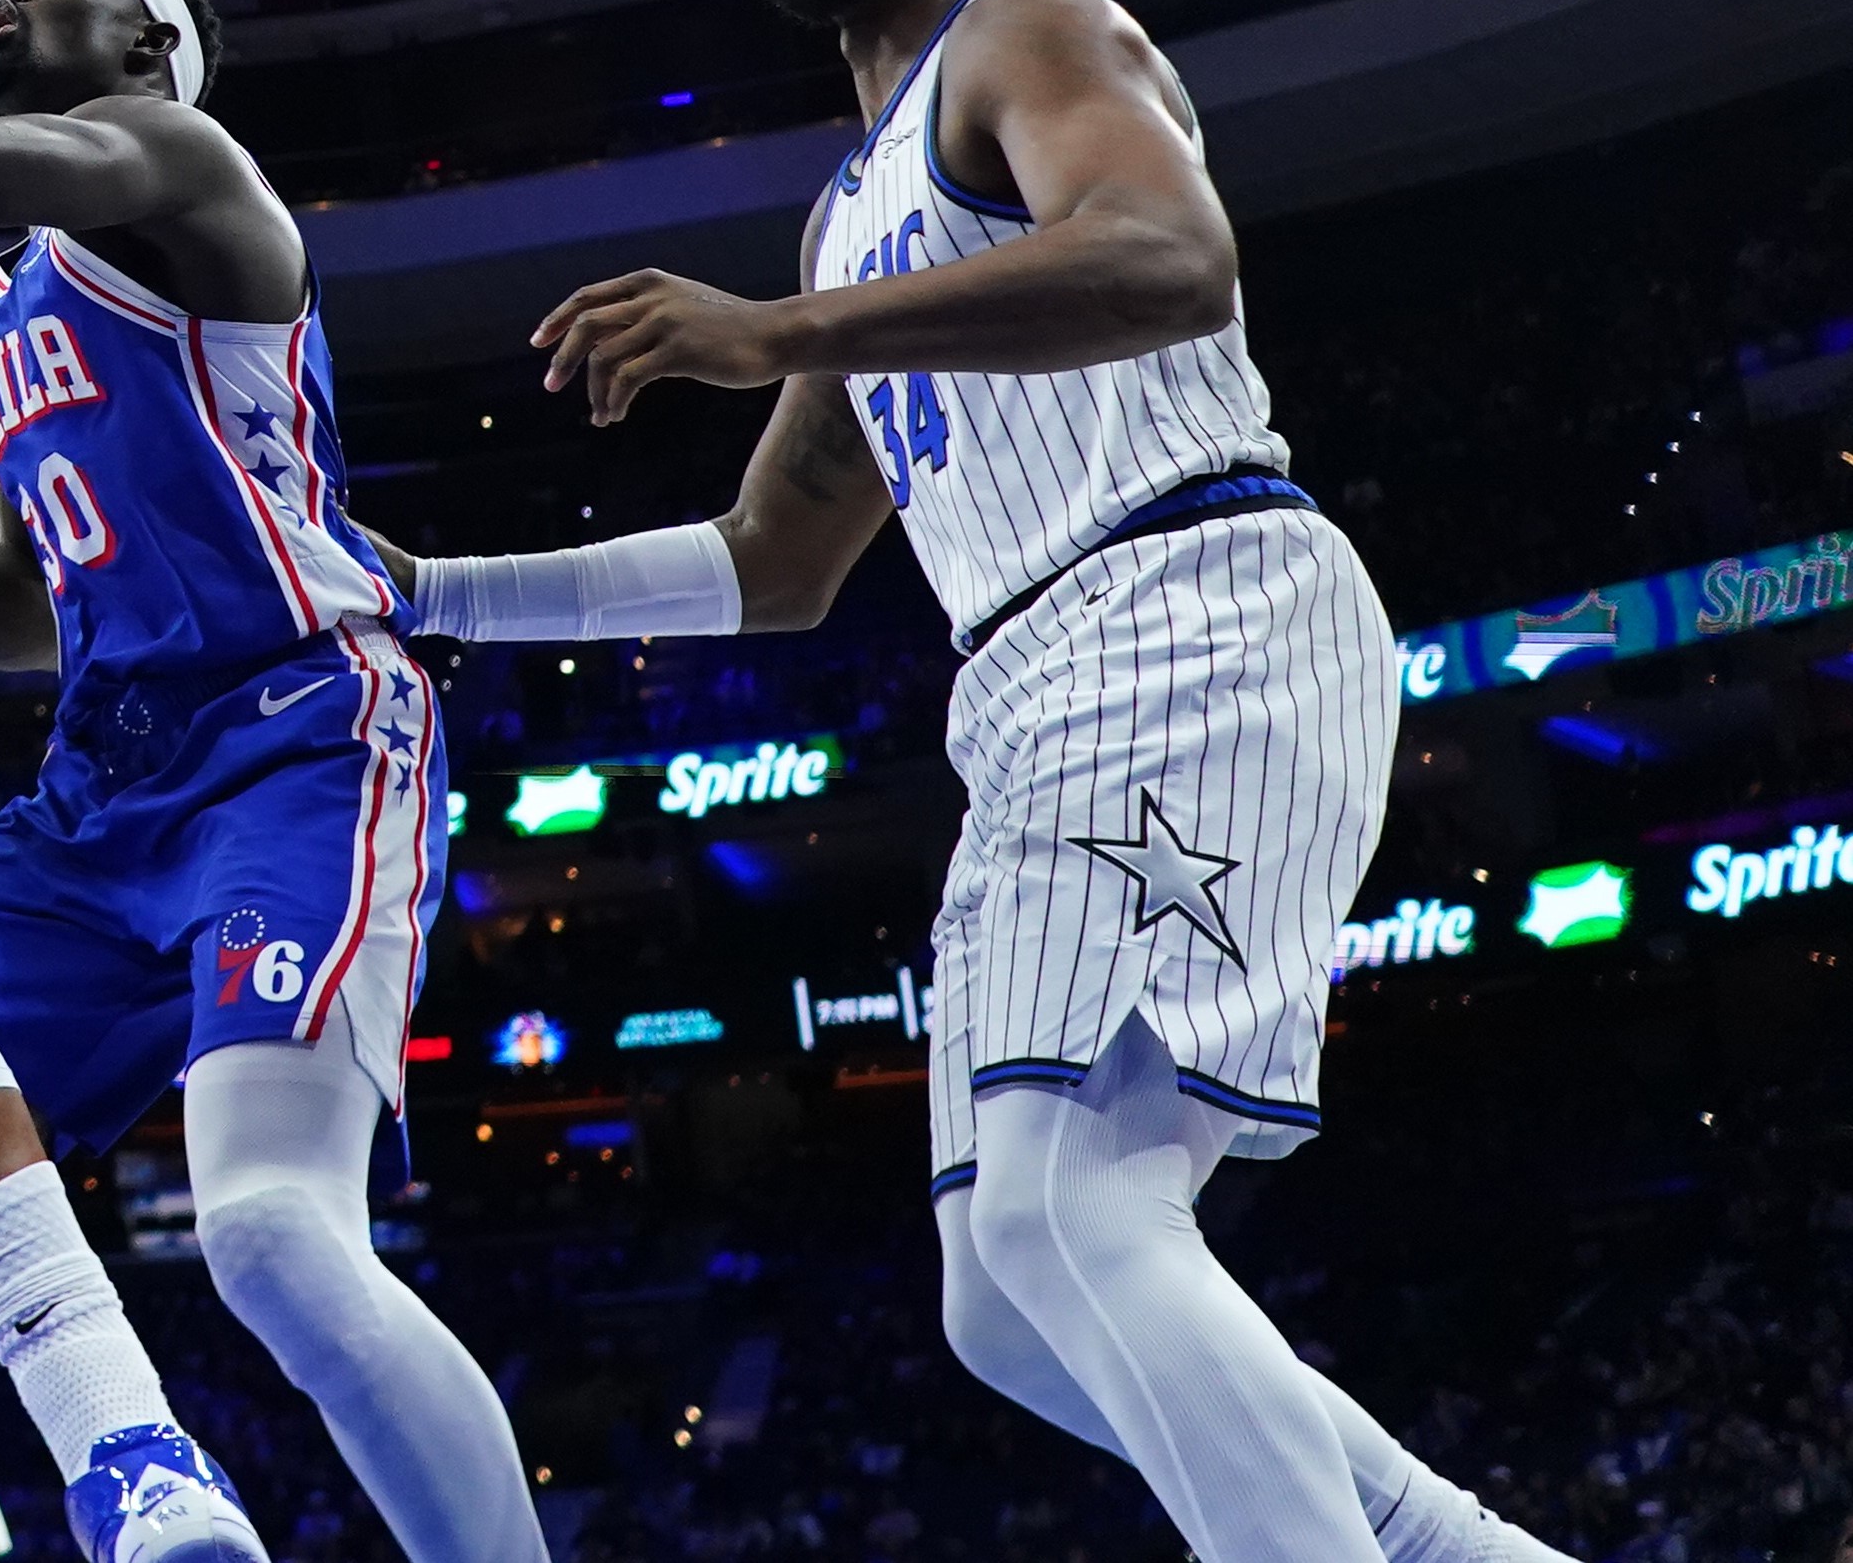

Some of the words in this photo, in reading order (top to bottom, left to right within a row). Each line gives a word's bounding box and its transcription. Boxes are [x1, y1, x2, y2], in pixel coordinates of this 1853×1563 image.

[866, 371, 951, 511] 34
[659, 741, 830, 817] Sprite
[215, 940, 305, 1007] 76
